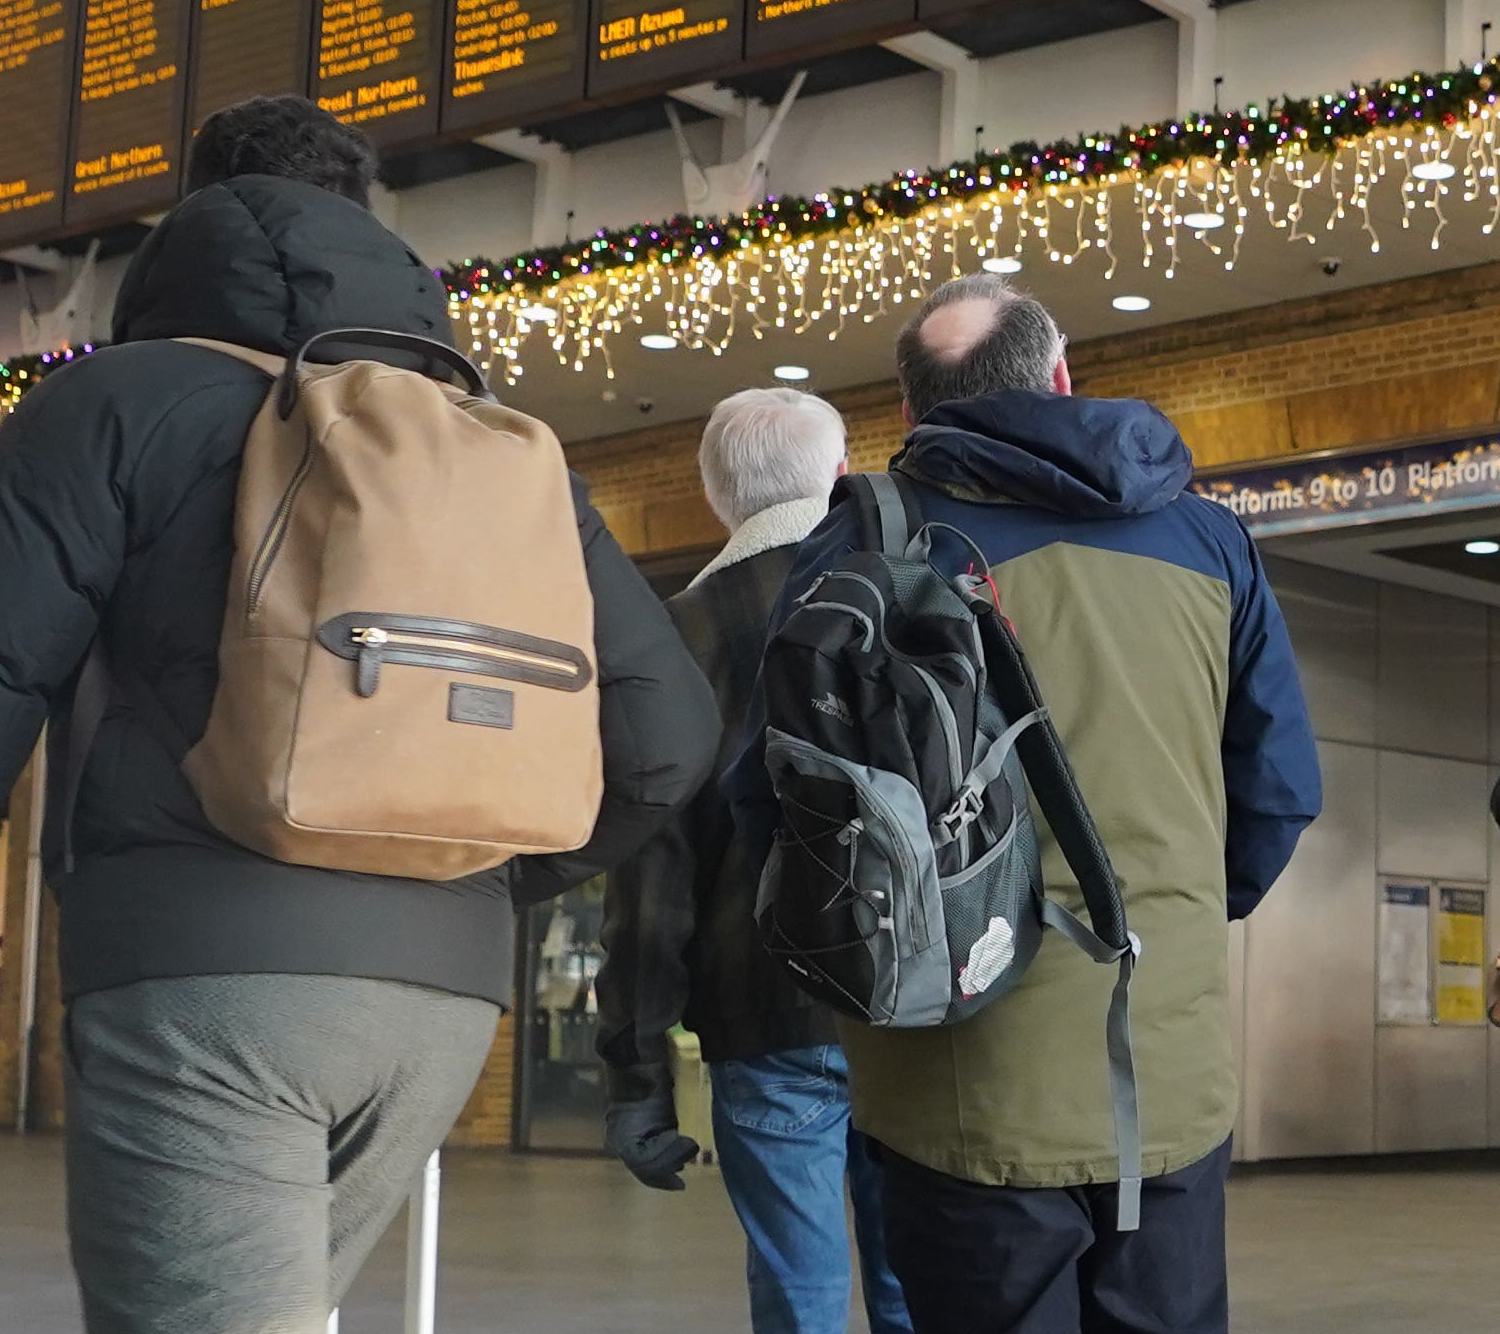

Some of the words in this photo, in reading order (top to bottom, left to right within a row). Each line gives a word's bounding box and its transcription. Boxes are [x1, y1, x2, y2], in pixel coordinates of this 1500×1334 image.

[1310, 476, 1326, 506] 9
[1331, 475, 1358, 502] to
[1365, 467, 1396, 498] 10
